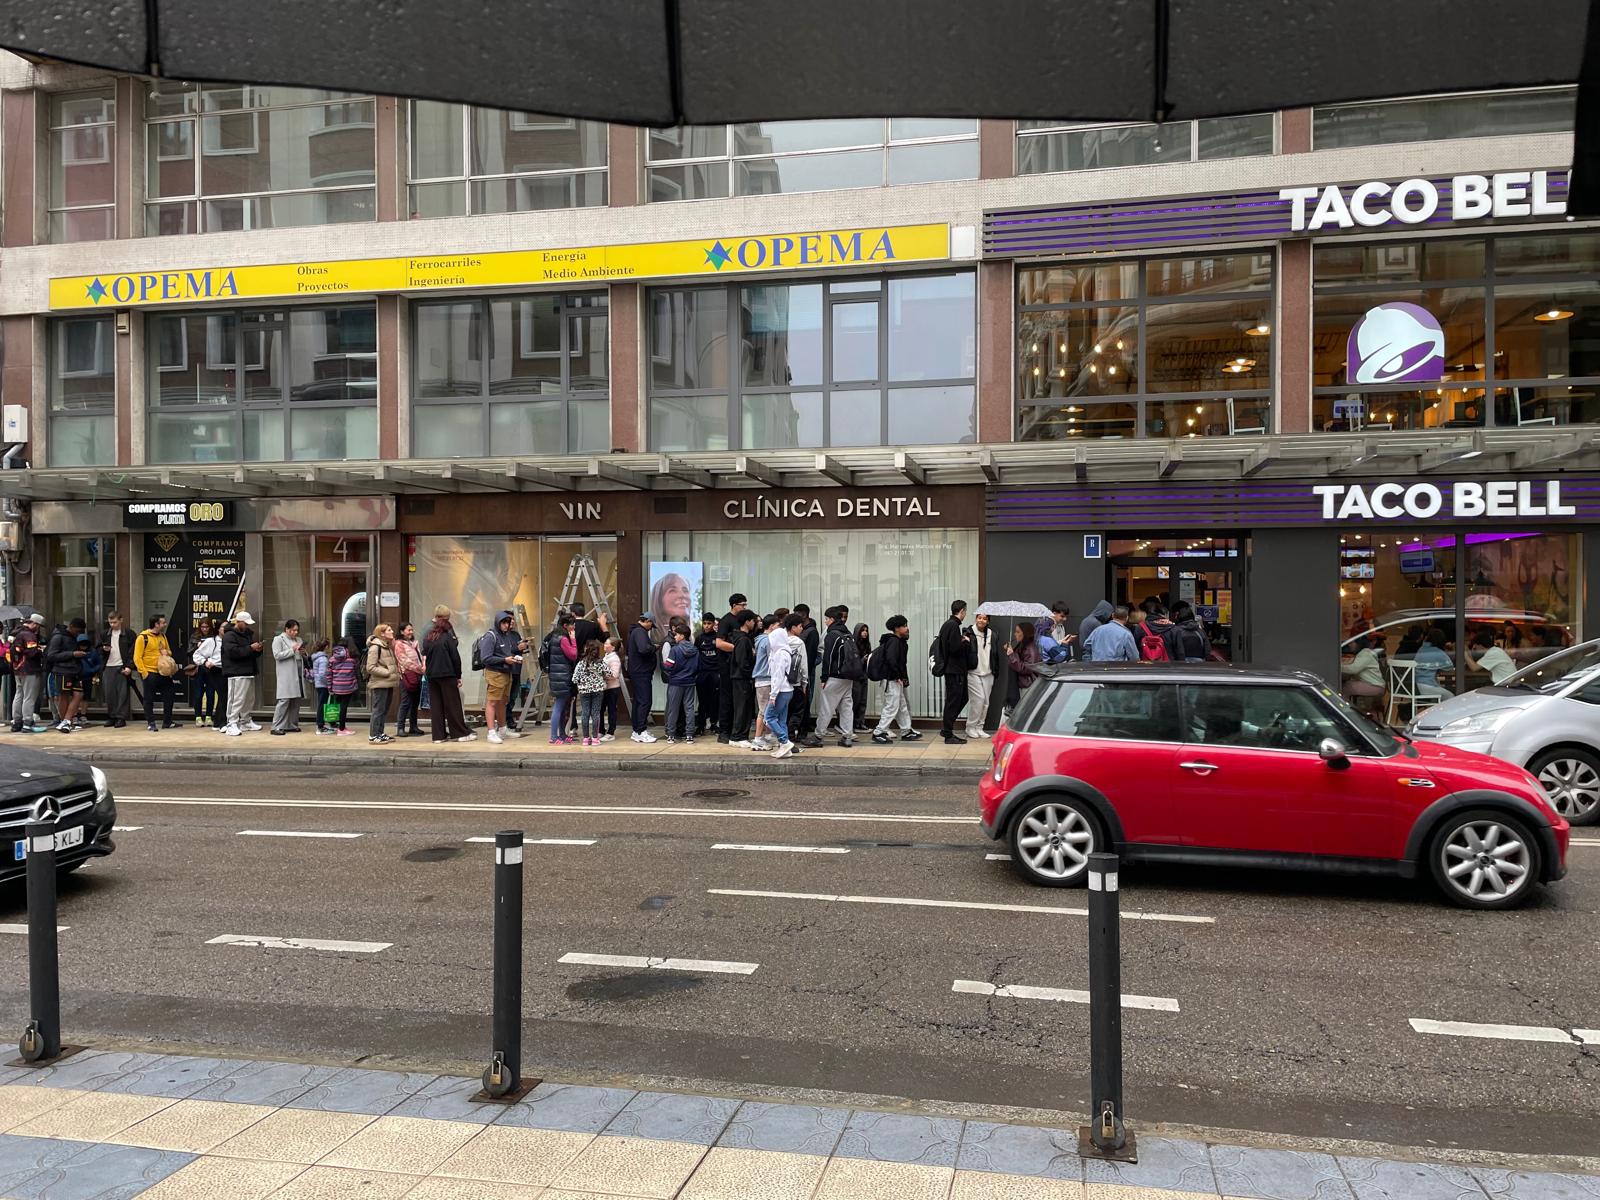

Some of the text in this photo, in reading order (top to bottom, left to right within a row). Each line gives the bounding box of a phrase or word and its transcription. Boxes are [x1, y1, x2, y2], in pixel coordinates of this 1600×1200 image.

[1279, 169, 1572, 231] TACO BEL
[738, 230, 896, 268] OPEMA
[297, 266, 328, 276] Obras
[409, 258, 481, 270] Ferrocarriles
[543, 266, 635, 279] Medio Ambiente
[112, 270, 239, 303] OPEMA
[297, 281, 349, 293] Proyectos
[128, 504, 187, 513] COMPRAMOS
[724, 495, 941, 519] CLÍNICA DENTAL
[1312, 480, 1576, 519] TACO BELL
[157, 514, 186, 525] PLATA
[189, 502, 224, 521] ORO
[559, 502, 601, 519] VIN
[333, 536, 348, 562] 4
[193, 601, 224, 613] OFERTA
[62, 828, 81, 848] KLJ
